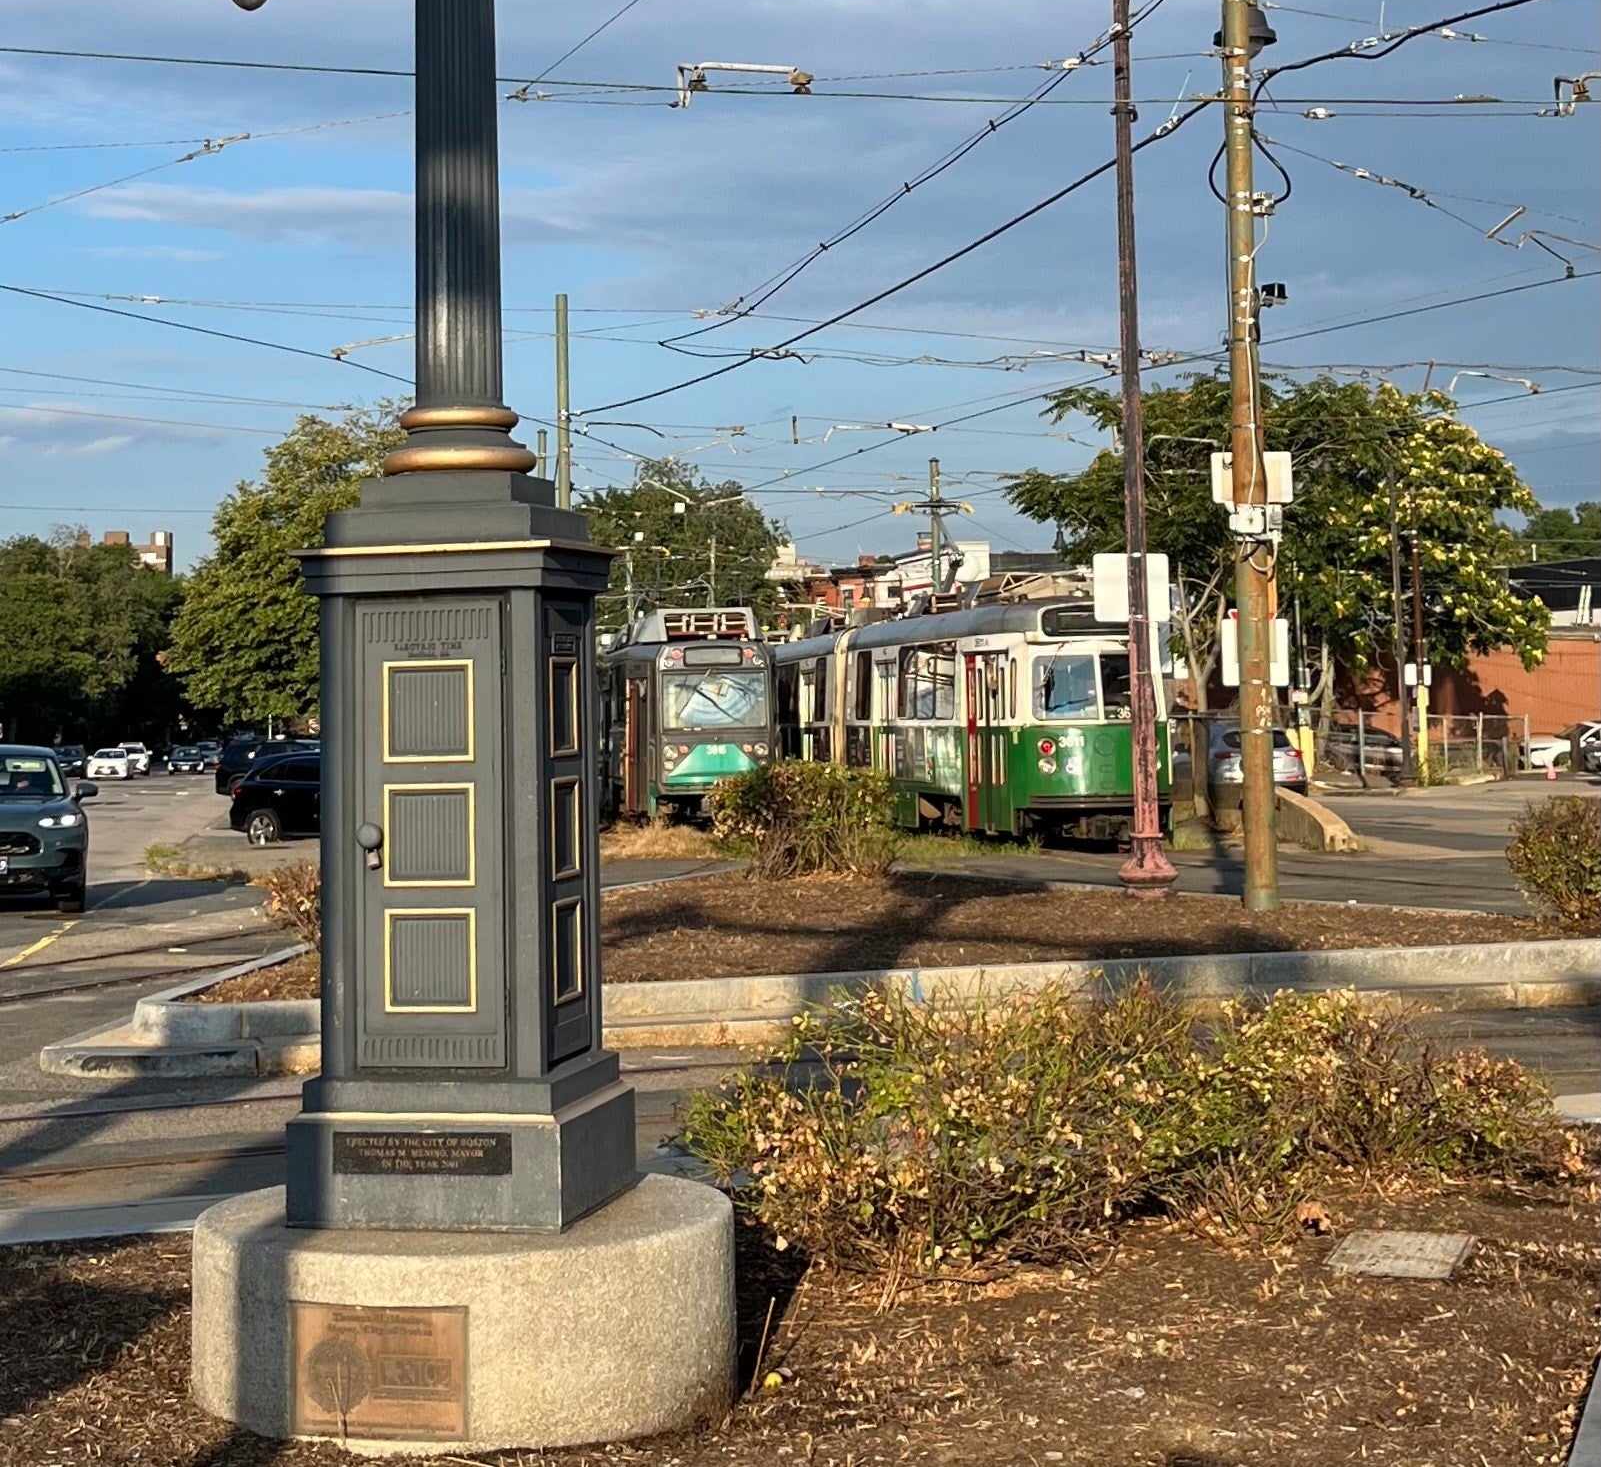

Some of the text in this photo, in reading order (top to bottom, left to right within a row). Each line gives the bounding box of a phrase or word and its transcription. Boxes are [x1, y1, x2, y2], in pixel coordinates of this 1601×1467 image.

[388, 1137, 401, 1147] BY
[403, 1138, 422, 1147] THE
[423, 1138, 444, 1147] CITY
[445, 1138, 459, 1147] OF
[461, 1137, 497, 1147] BOSTON
[359, 1148, 396, 1158] THOMAS
[450, 1148, 484, 1158] MAYOR
